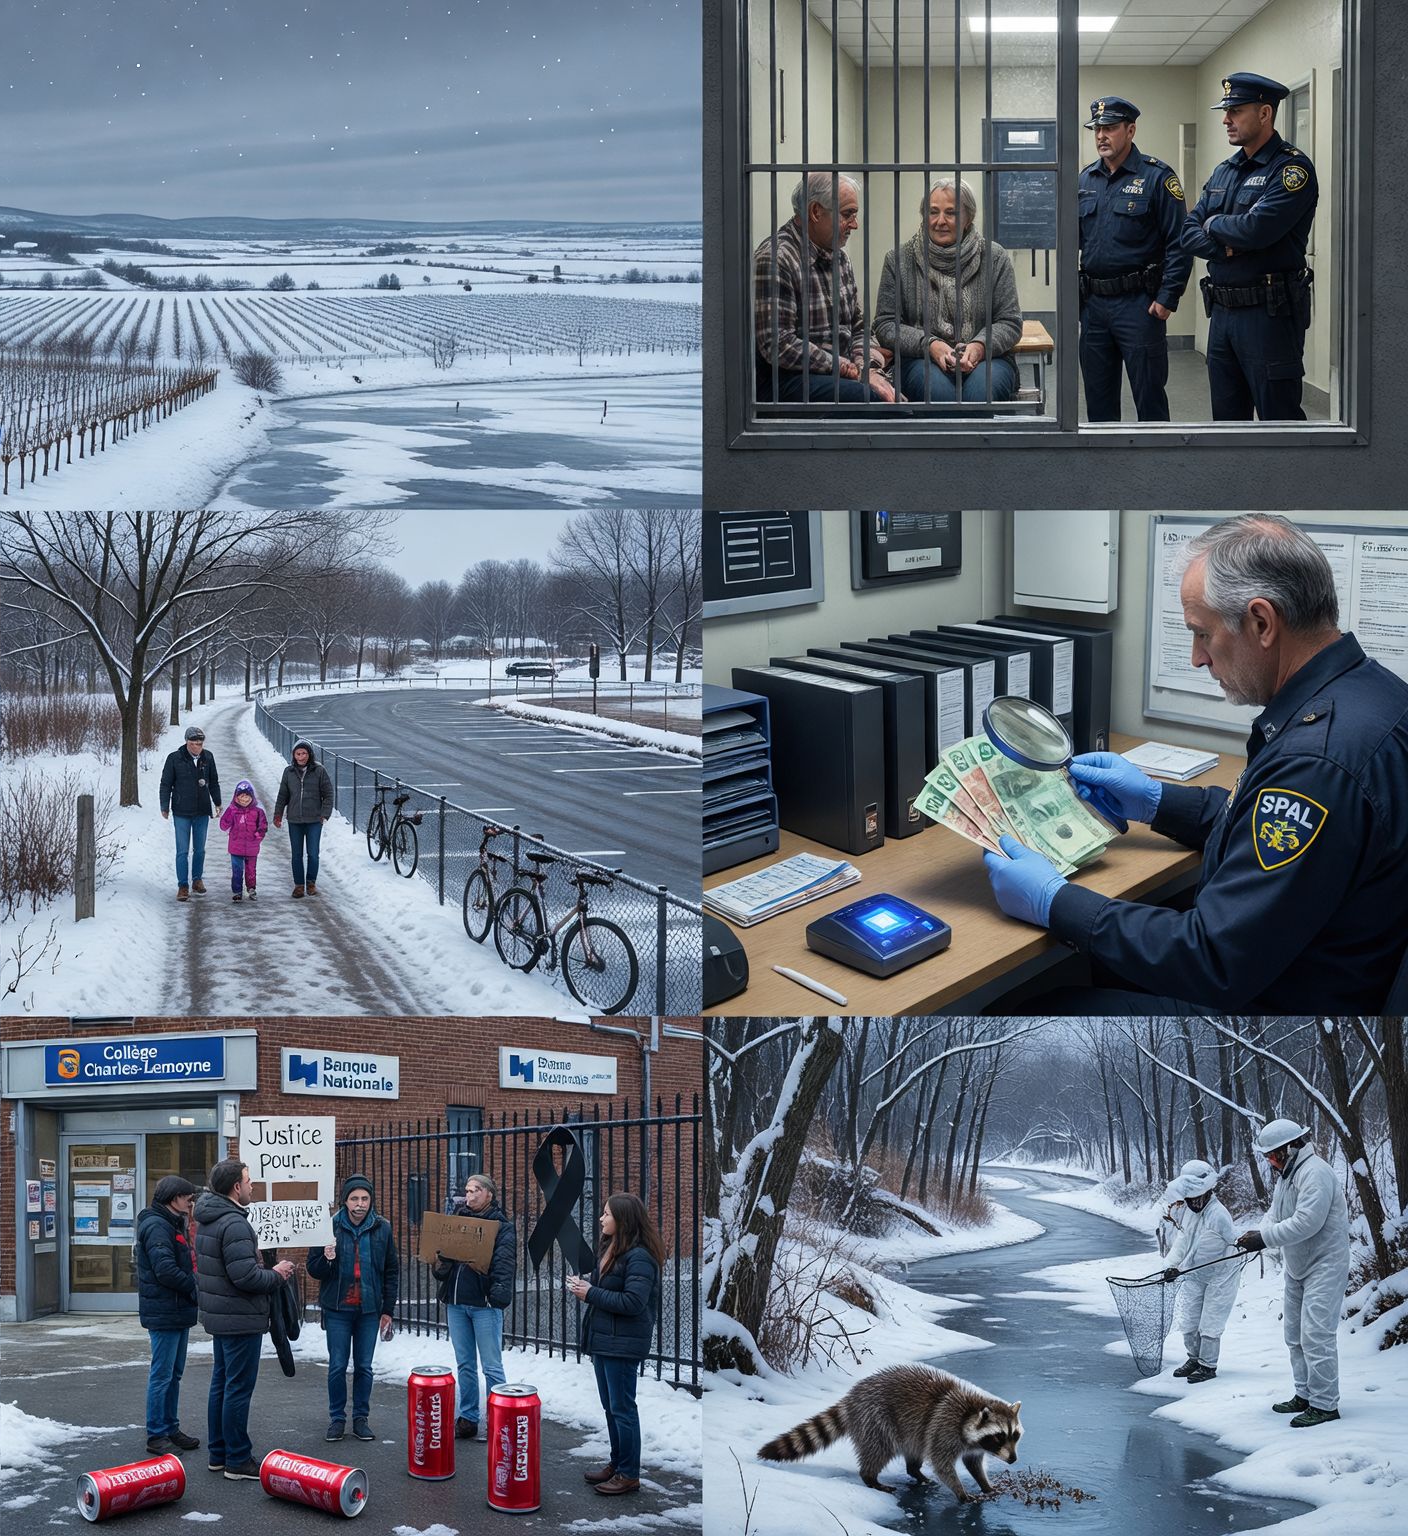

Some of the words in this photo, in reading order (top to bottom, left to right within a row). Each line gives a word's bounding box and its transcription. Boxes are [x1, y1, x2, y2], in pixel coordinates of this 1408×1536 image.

[1260, 795, 1313, 830] SPAL
[103, 1044, 158, 1062] Collège
[84, 1059, 211, 1077] Charles-Lemoyne
[323, 1056, 377, 1075] Banque
[323, 1074, 393, 1091] Nationale
[248, 1119, 323, 1146] Justice
